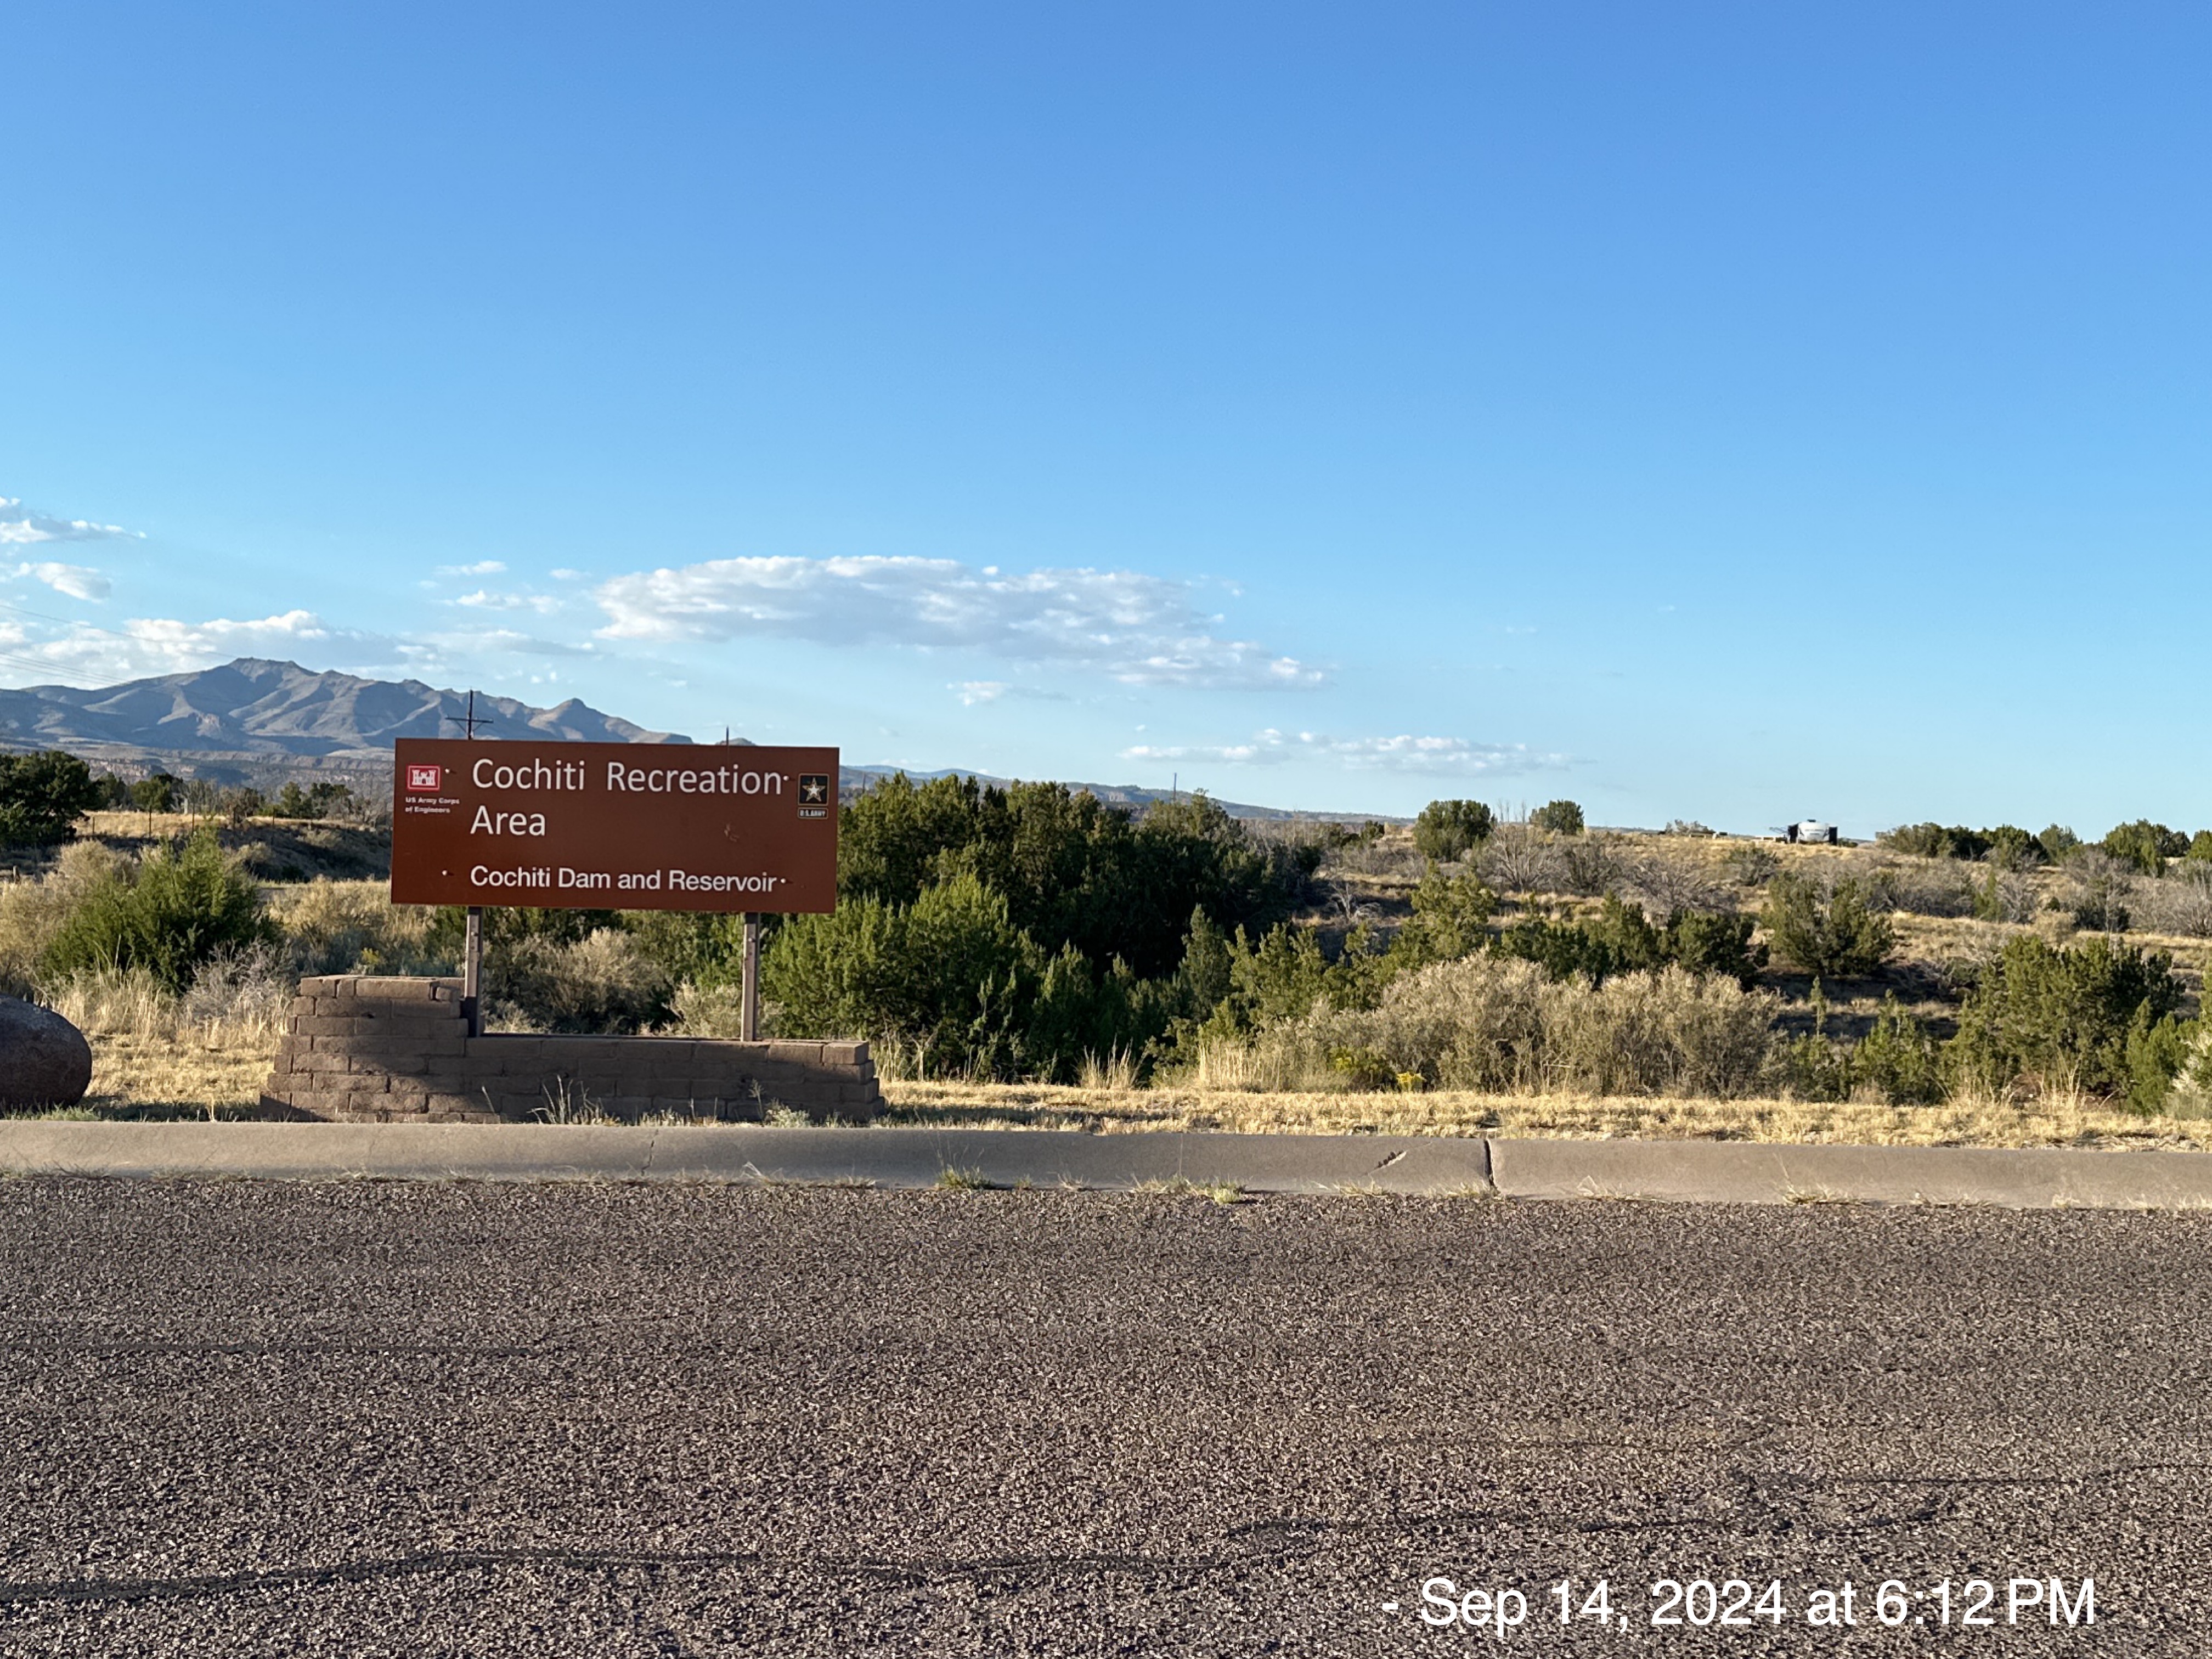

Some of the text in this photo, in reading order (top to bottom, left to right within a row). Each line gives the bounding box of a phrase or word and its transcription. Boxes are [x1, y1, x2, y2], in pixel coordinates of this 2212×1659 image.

[472, 758, 782, 795] Cochiti Recreation
[470, 805, 546, 837] Area
[470, 865, 777, 893] Cochiti Dam and Reservoir
